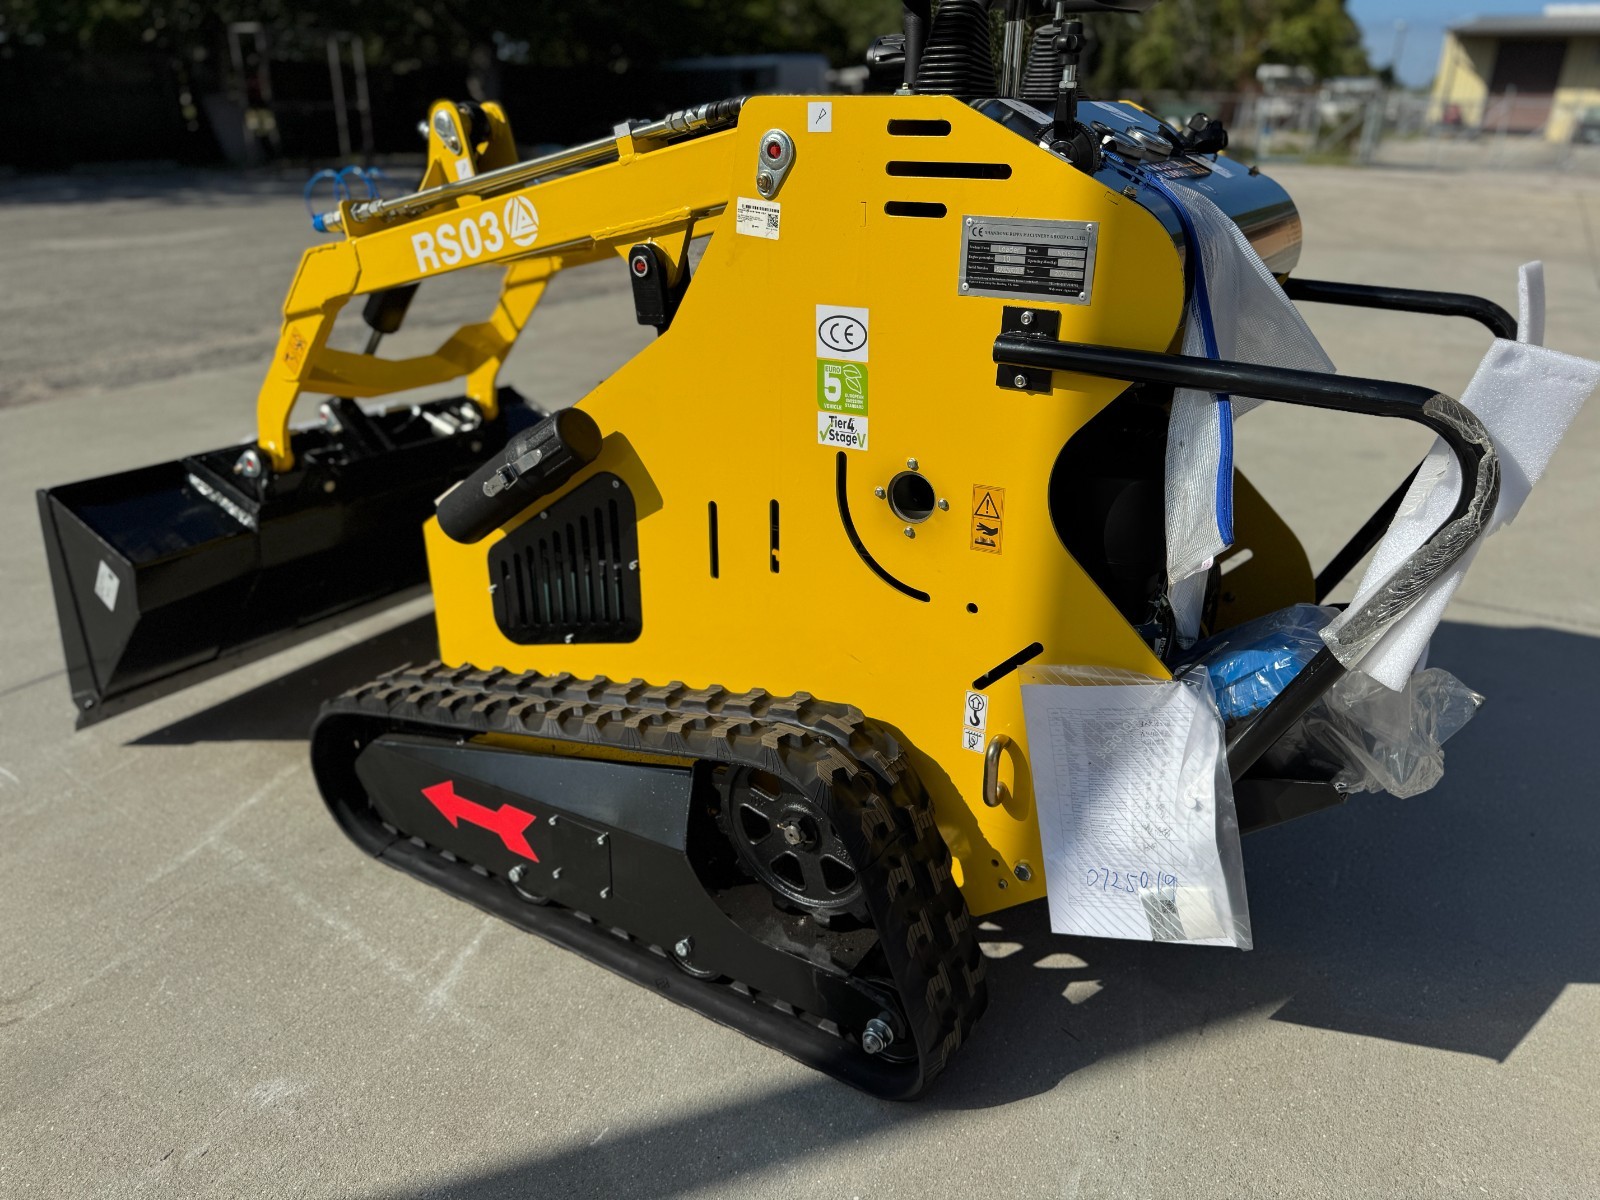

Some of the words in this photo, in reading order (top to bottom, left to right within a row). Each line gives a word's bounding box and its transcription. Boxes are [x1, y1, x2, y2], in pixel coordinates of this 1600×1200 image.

[411, 211, 504, 273] RS03
[998, 244, 1020, 254] Loader
[830, 322, 854, 345] CE
[825, 366, 841, 374] EURO
[824, 373, 842, 402] 5
